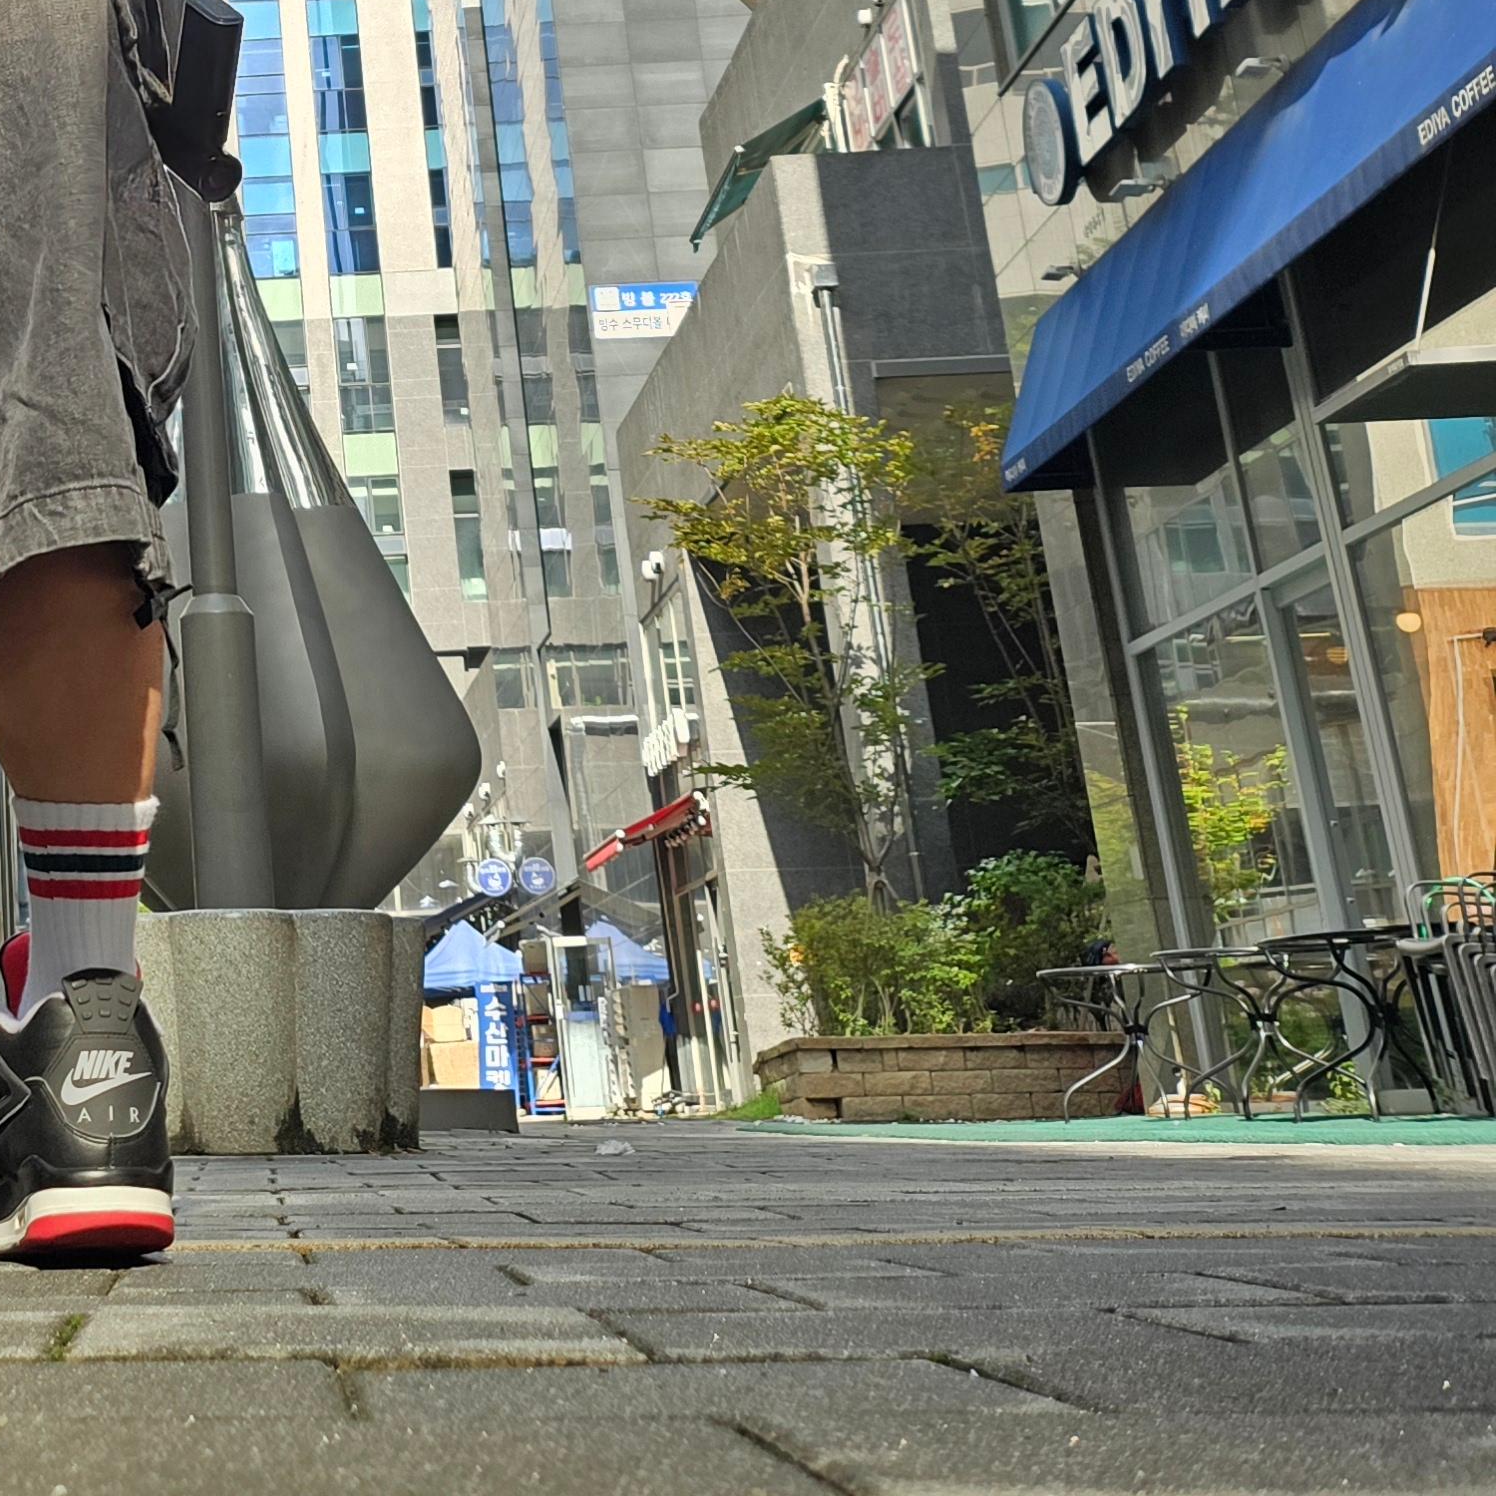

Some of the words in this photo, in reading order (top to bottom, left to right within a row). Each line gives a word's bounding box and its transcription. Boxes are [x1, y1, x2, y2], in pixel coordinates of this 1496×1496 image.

[1417, 106, 1451, 145] EDIYA
[1451, 64, 1496, 119] COFFEE
[599, 318, 619, 332] 빙수
[73, 1050, 134, 1081] NIKE
[77, 1107, 140, 1123] AIR
